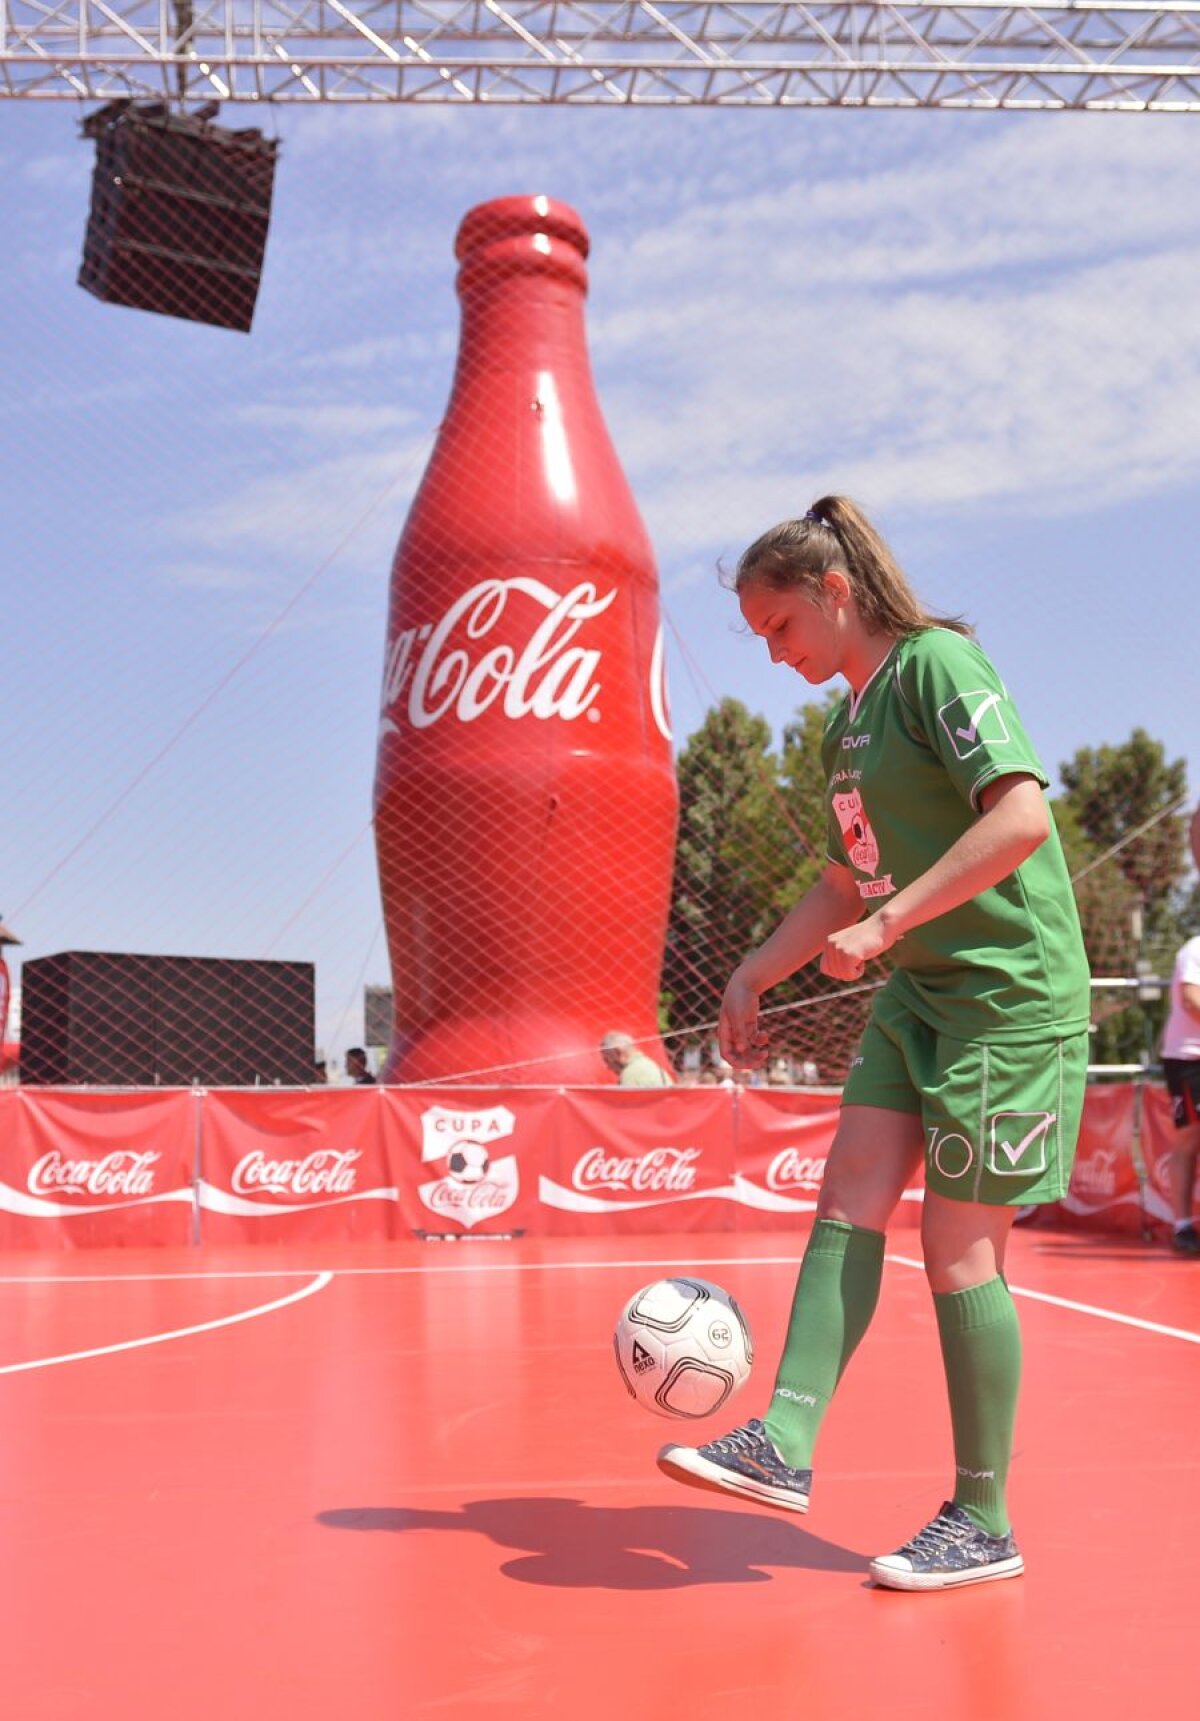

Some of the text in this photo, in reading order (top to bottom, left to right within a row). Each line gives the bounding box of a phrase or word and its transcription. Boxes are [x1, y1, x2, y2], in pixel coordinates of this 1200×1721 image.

[382, 576, 618, 729] a-Cola
[435, 1119, 500, 1132] CUPA
[27, 1150, 162, 1195] Coca-Cola
[231, 1149, 363, 1194] Coca-Cola
[571, 1147, 703, 1191] Coca-Cola
